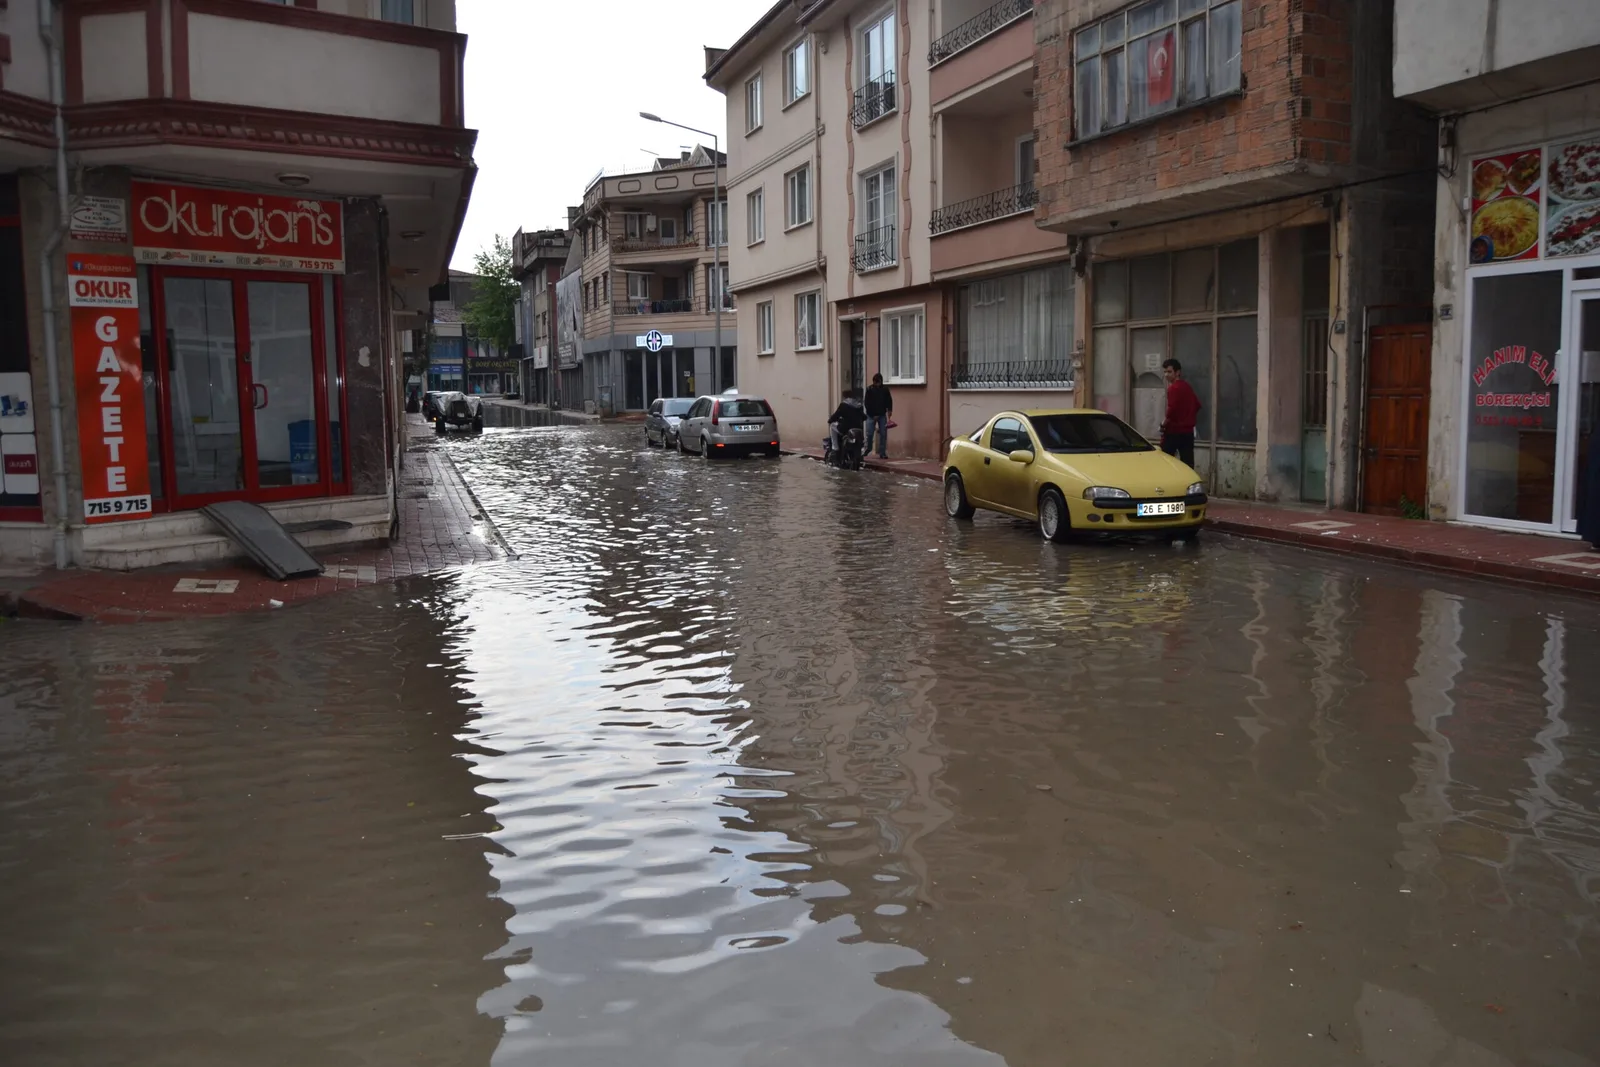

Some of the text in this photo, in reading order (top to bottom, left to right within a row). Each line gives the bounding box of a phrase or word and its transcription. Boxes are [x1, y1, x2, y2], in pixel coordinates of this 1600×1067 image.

[298, 260, 334, 270] 715 9 715
[75, 280, 132, 299] OKUR
[1472, 345, 1558, 388] HANIM ELİ
[95, 315, 127, 492] GAZETE
[1475, 391, 1551, 410] BÖREKÇİSİ
[88, 498, 148, 515] 715 9 715
[1143, 502, 1184, 514] 26 E 1980
